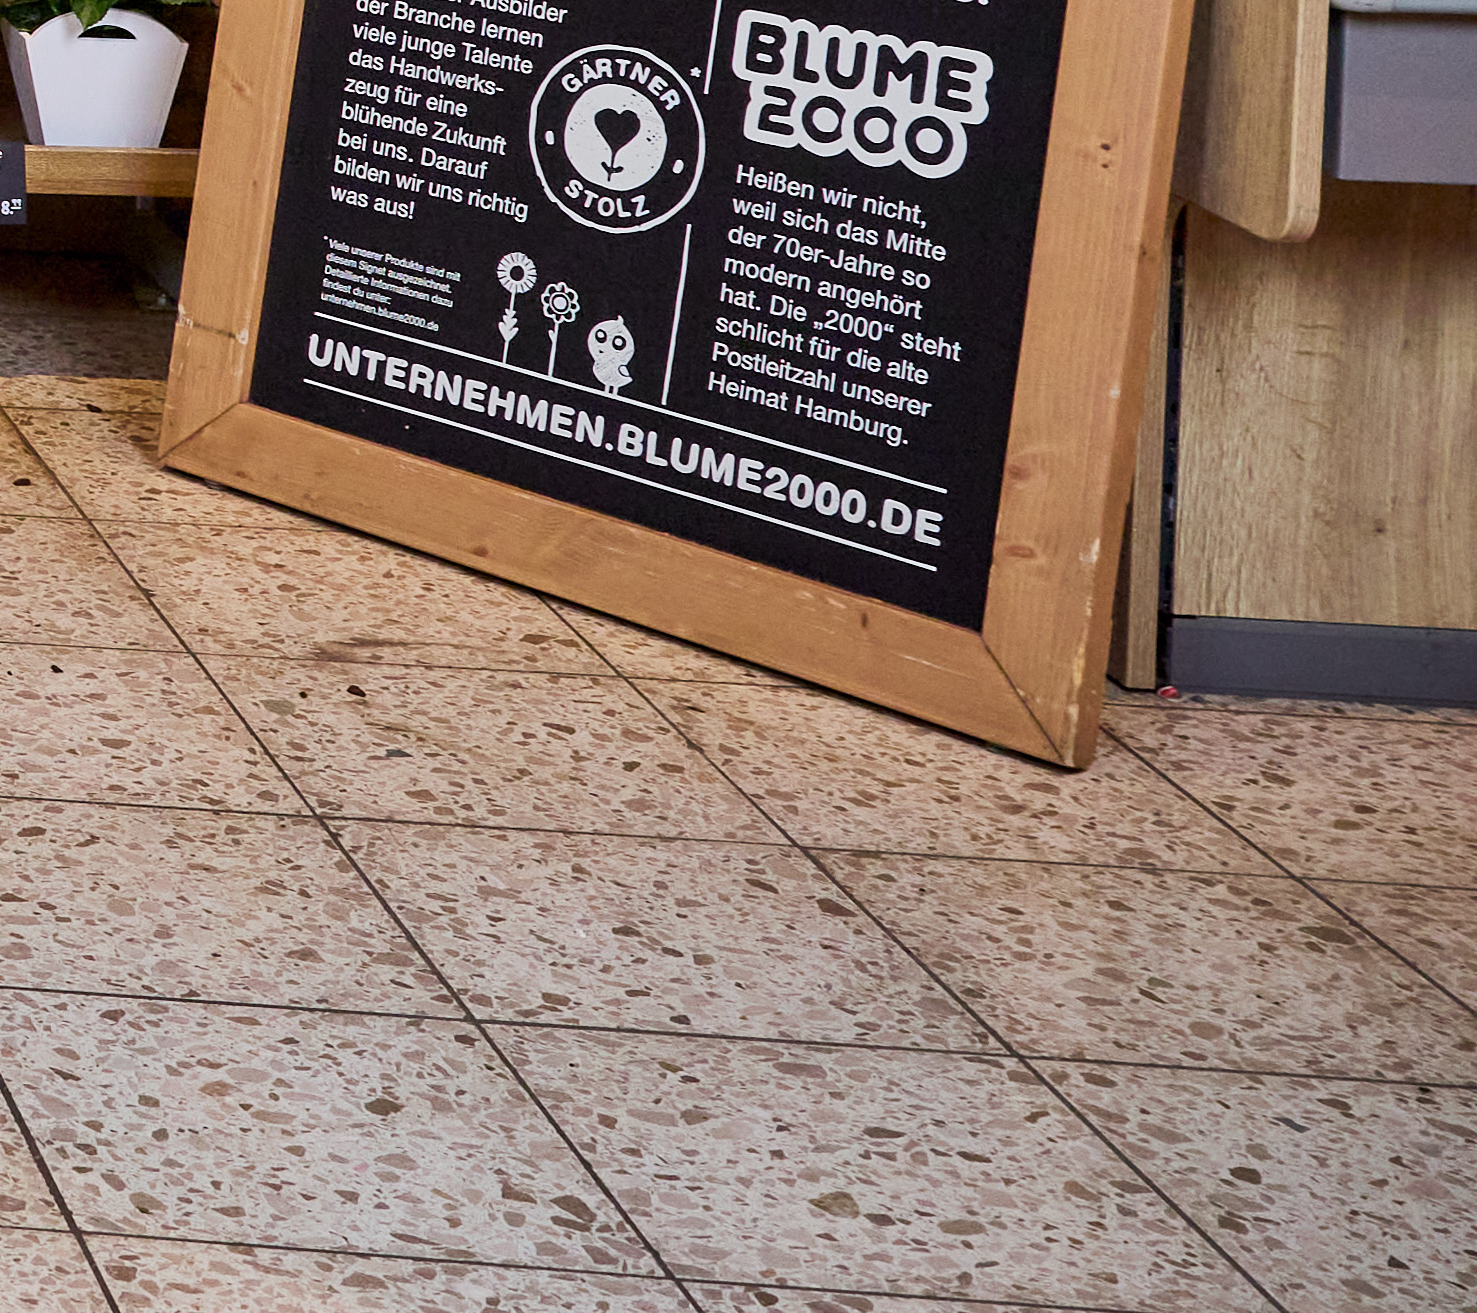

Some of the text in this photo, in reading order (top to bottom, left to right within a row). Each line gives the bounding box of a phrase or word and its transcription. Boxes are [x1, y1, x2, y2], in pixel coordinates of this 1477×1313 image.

[561, 57, 682, 112] GÄRTNER
[744, 20, 978, 115] BLUME
[757, 83, 954, 167] 2000
[564, 178, 651, 219] STOLZ
[307, 332, 943, 546] UNTERNEHMEN.BLUME2000.DE
